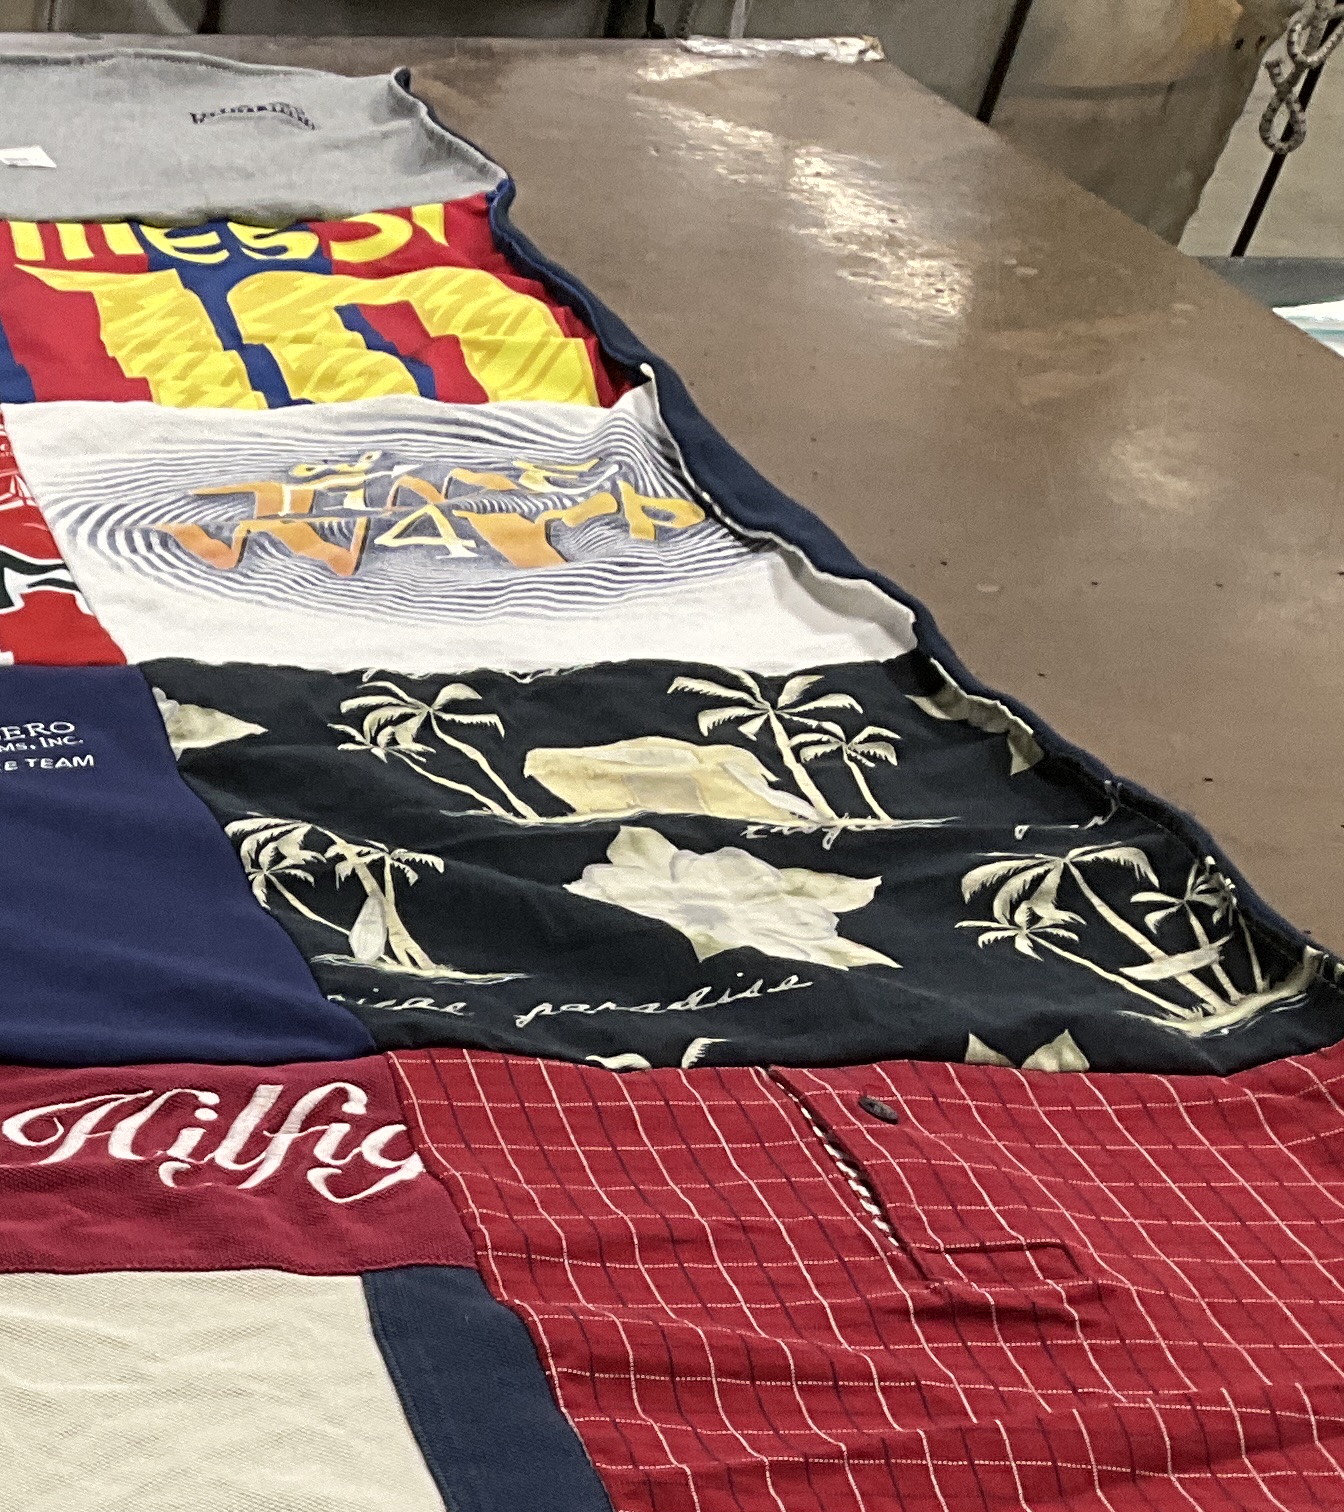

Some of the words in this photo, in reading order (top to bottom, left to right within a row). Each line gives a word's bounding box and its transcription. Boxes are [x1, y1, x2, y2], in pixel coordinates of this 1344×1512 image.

[39, 735, 84, 749] INC.
[22, 753, 96, 770] TEAM
[513, 971, 814, 1028] paradise
